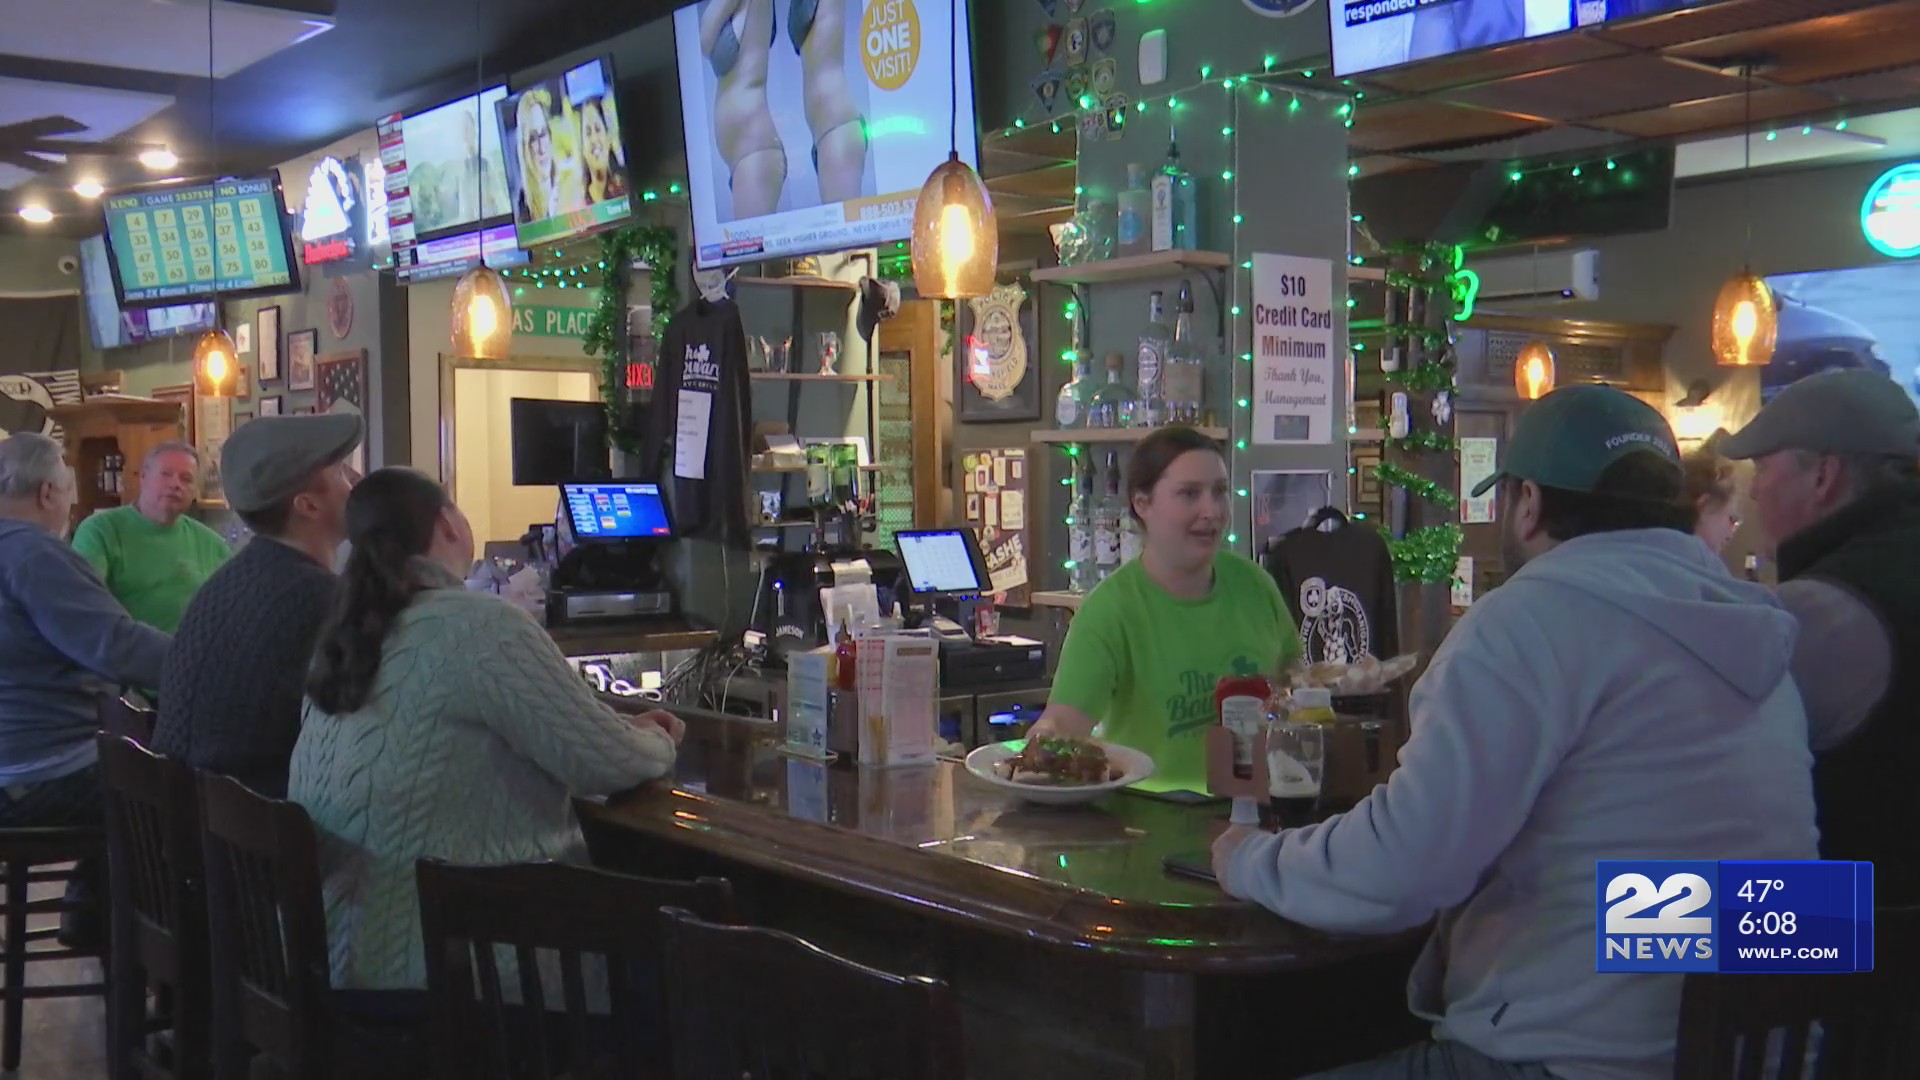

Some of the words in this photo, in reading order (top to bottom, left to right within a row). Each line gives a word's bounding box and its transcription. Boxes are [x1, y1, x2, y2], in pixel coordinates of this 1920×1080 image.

[870, 0, 904, 28] JUST
[867, 22, 910, 56] ONE
[871, 52, 911, 80] VISIT!
[146, 194, 174, 205] GAME
[221, 187, 236, 196] NO
[238, 183, 268, 194] BONUS
[134, 217, 141, 226] 4
[162, 213, 168, 223] 7
[187, 210, 200, 220] 29
[245, 203, 256, 213] 31
[134, 236, 147, 245] 33
[163, 232, 176, 242] 34
[191, 228, 204, 238] 36
[219, 225, 231, 235] 37
[248, 222, 260, 232] 43
[793, 232, 817, 245] HIGHER
[853, 224, 877, 236] NEVER
[138, 254, 150, 263] 47
[167, 250, 180, 260] 50
[195, 247, 208, 257] 53
[223, 244, 236, 254] 56
[252, 240, 264, 251] 58
[142, 272, 155, 281] 59
[170, 269, 183, 279] 63
[198, 266, 210, 275] 69
[226, 262, 239, 272] 75
[254, 260, 268, 269] 80
[1281, 274, 1306, 297] $10
[512, 308, 534, 332] AS
[1256, 304, 1297, 327] Credit
[1301, 306, 1331, 329] Card
[1262, 336, 1326, 359] Minimum
[1264, 366, 1297, 383] Thank
[1260, 390, 1326, 410] Management
[776, 624, 804, 639] JAMESON
[1180, 670, 1214, 696] The
